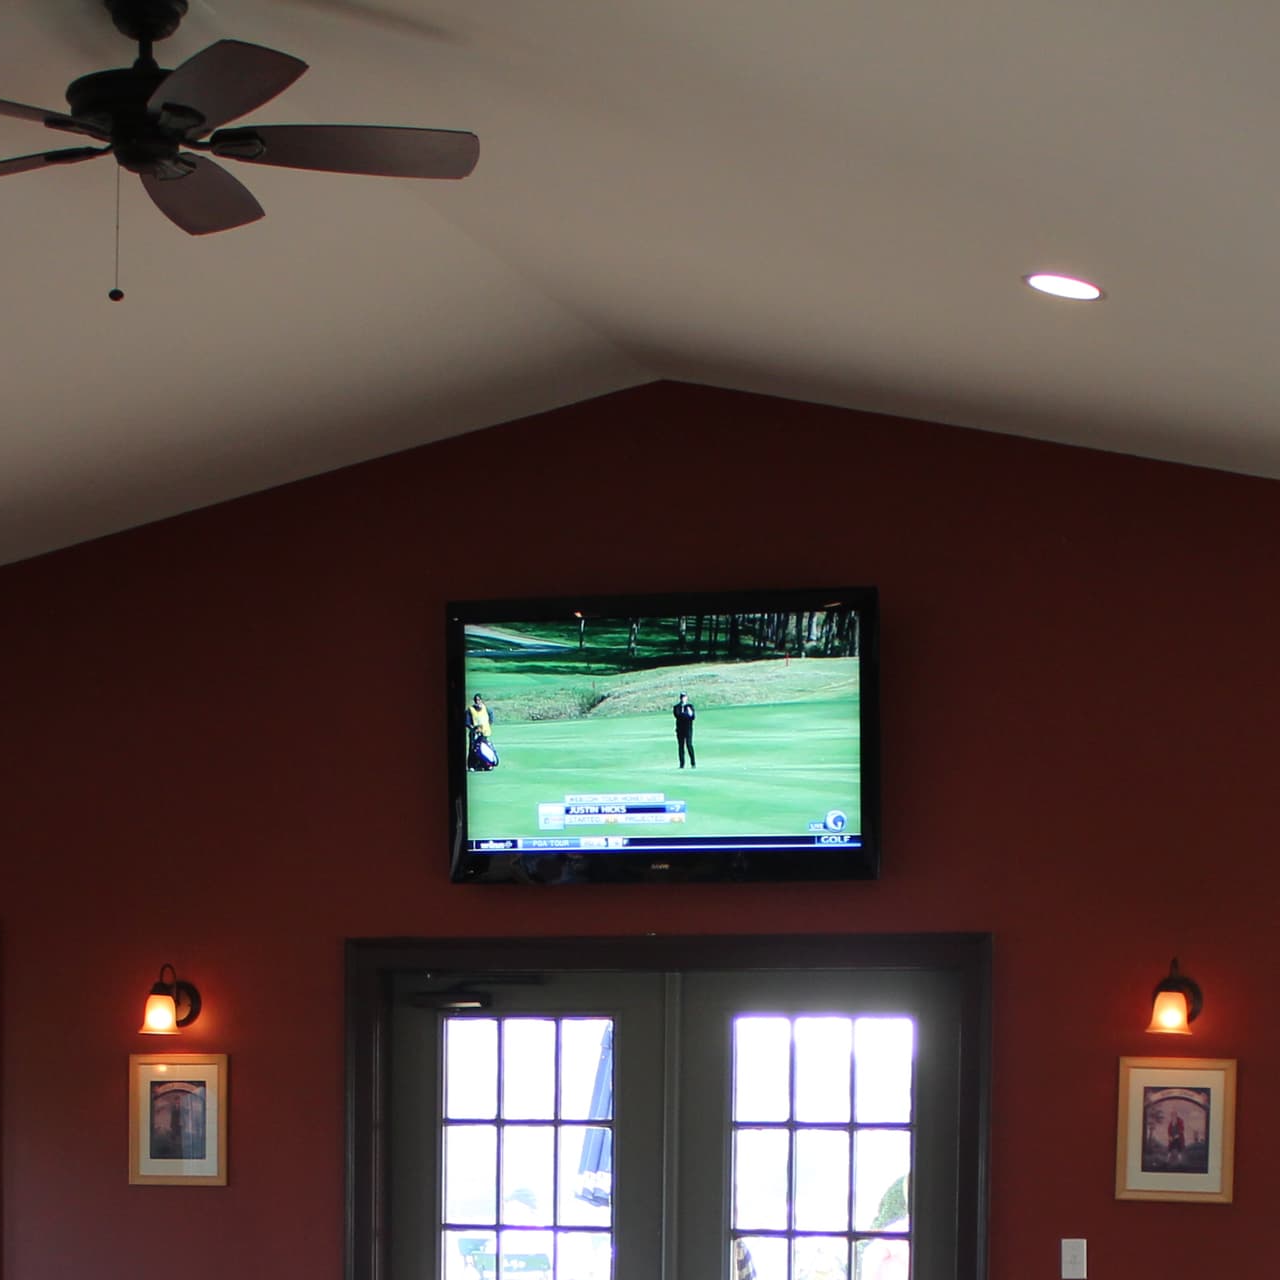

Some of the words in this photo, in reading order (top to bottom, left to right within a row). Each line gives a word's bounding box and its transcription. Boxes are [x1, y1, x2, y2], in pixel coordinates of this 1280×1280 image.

[569, 805, 599, 814] JUSTIN
[601, 804, 627, 814] HICKS
[532, 839, 548, 847] PGA
[550, 838, 569, 847] TOUR
[820, 835, 851, 844] GOLF
